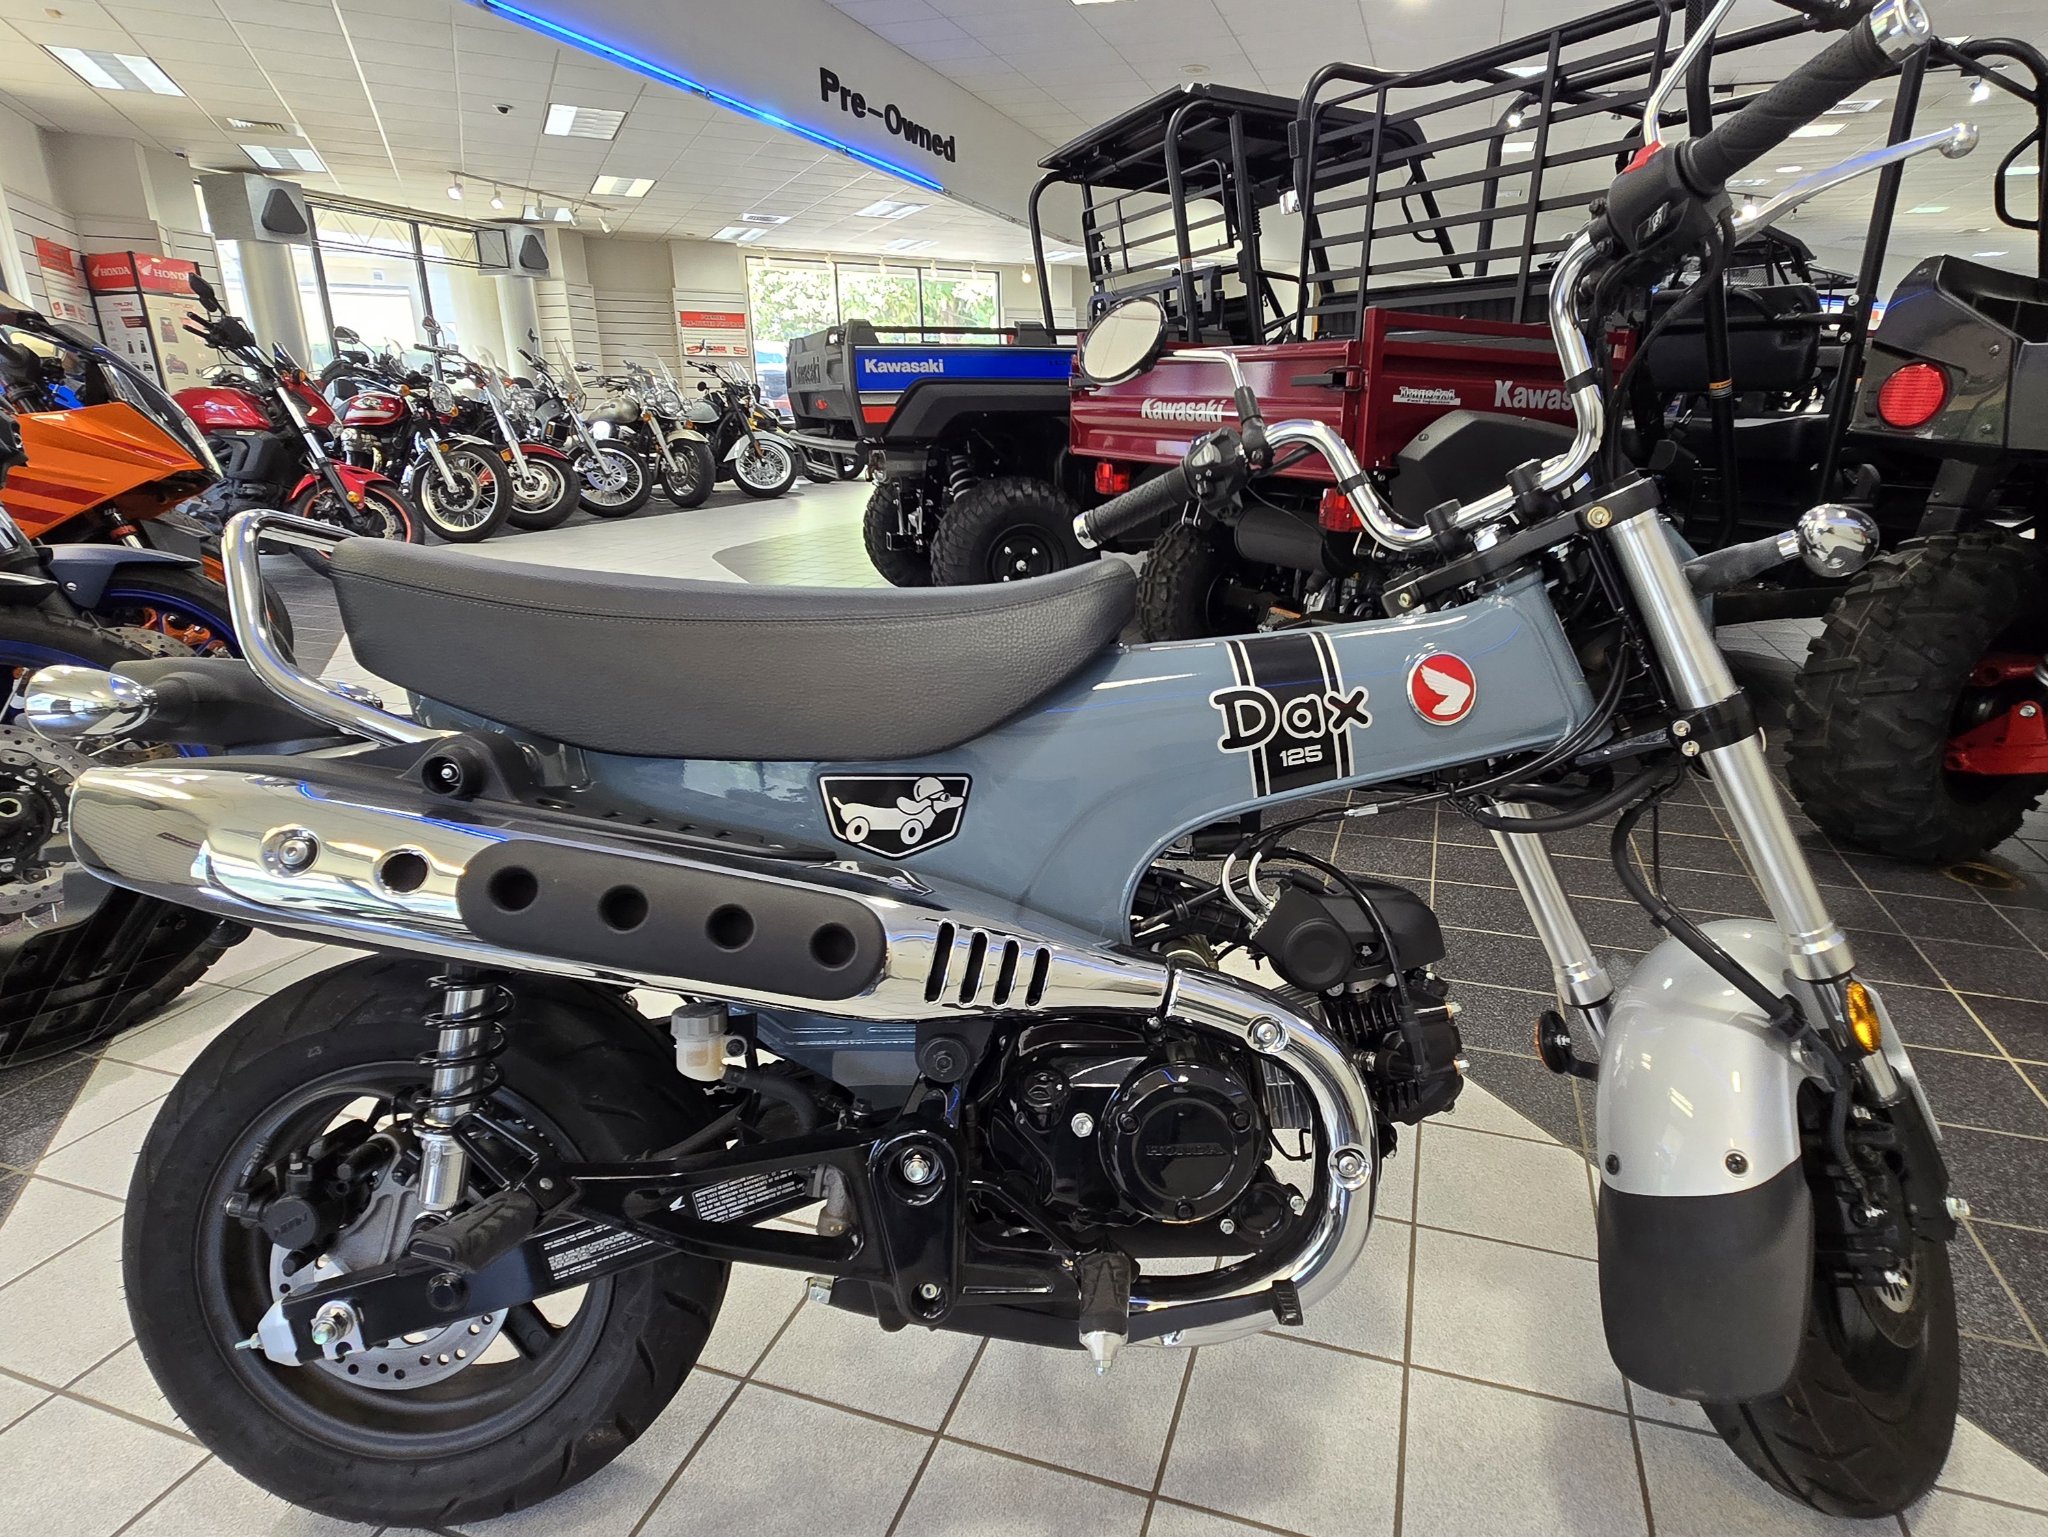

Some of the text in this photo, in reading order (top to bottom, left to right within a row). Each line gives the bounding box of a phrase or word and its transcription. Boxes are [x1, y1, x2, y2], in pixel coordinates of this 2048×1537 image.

[820, 67, 956, 163] Pre-Owned
[101, 266, 131, 277] HONDA
[153, 268, 190, 281] HOND
[864, 358, 944, 373] Kawasaki
[1494, 380, 1573, 411] Kawas
[1141, 398, 1227, 422] Kawasaki
[1209, 685, 1373, 754] Dax
[1280, 745, 1323, 767] 125
